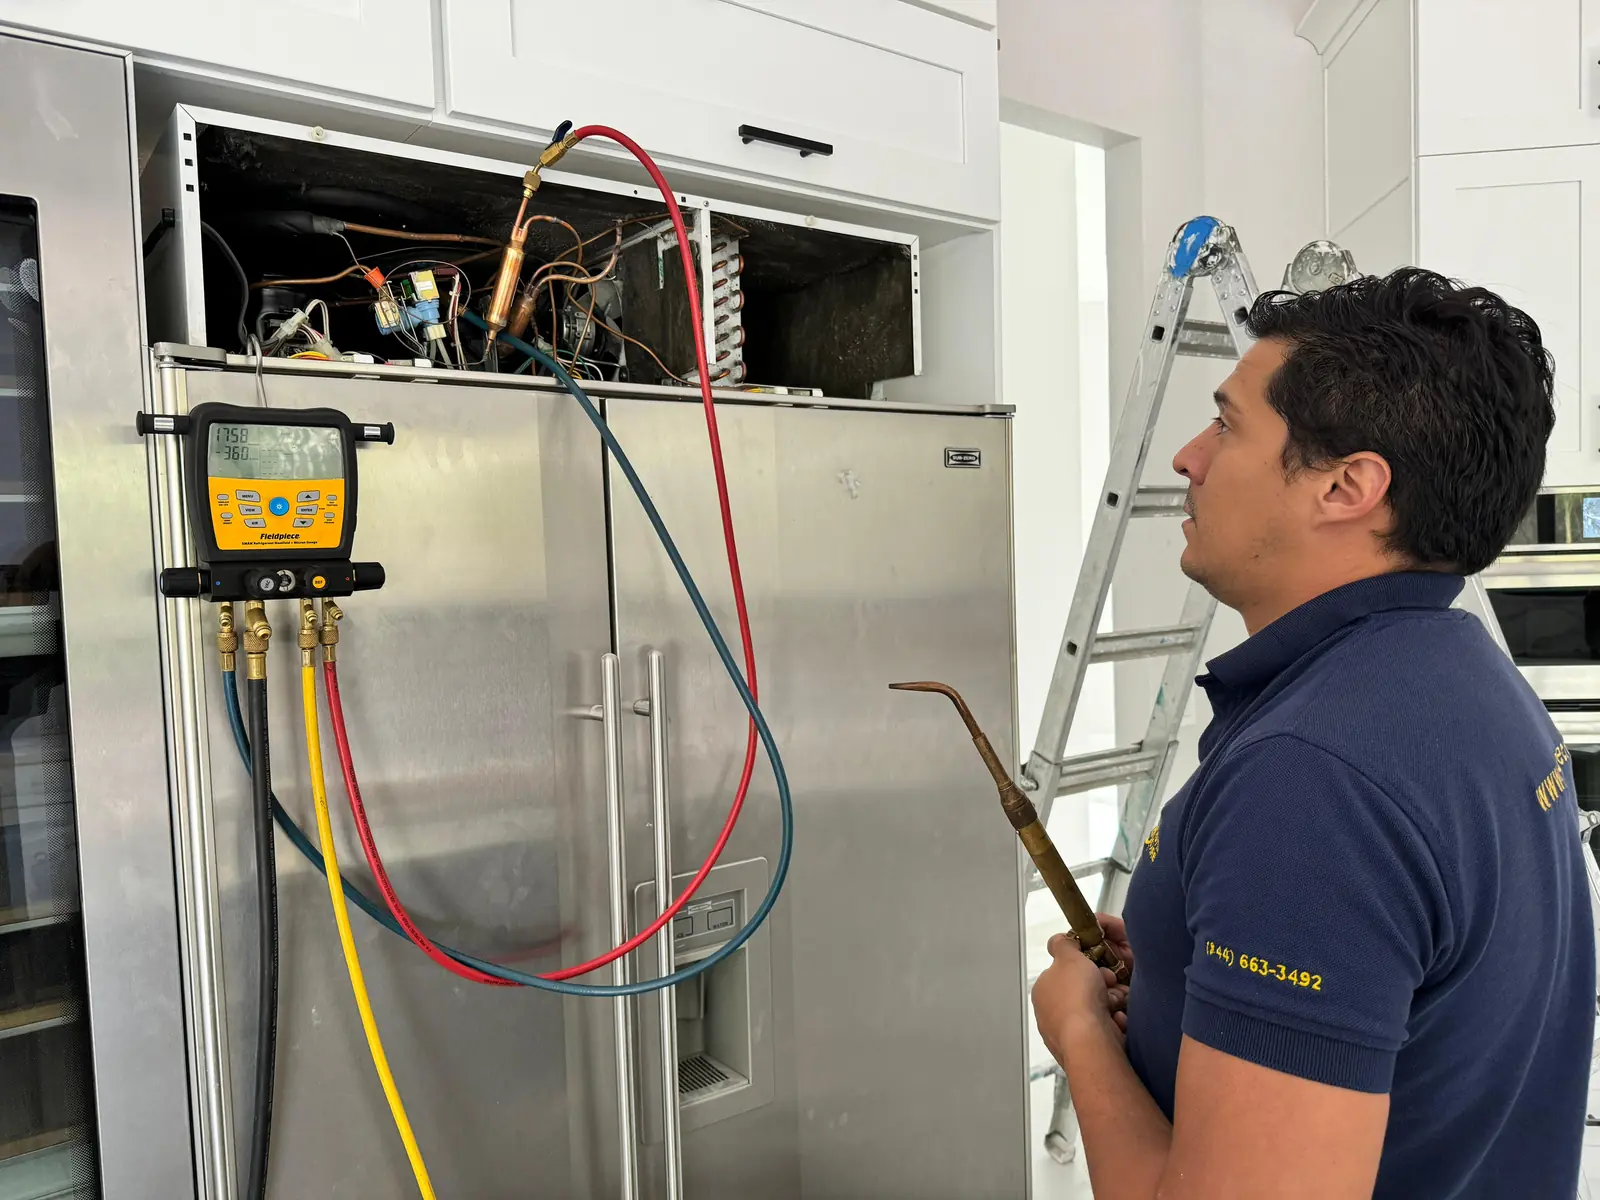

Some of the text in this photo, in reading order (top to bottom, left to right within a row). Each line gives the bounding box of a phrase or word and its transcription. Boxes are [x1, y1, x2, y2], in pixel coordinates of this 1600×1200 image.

[216, 427, 249, 443] 1758
[1206, 941, 1323, 991] (844) 663-3492
